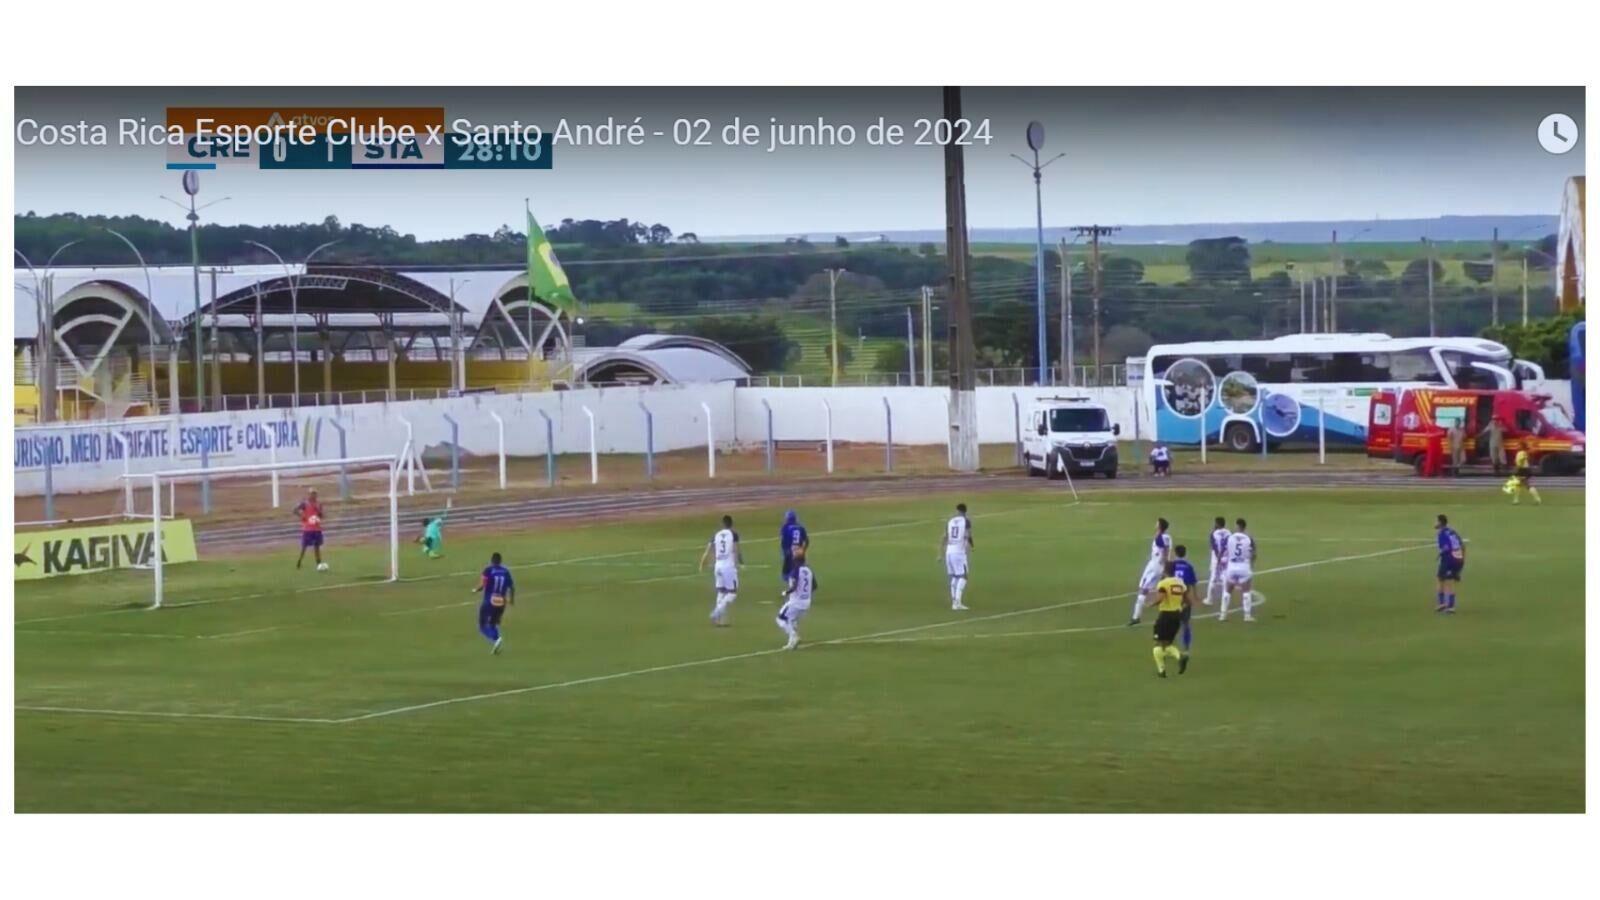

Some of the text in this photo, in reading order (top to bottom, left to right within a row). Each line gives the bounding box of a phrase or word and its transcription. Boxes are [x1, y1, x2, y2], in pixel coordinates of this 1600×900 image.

[1433, 396, 1476, 405] RESGATE
[70, 432, 102, 463] MEIO
[180, 425, 233, 454] ESPORTE
[43, 530, 167, 574] KAGIVA
[719, 540, 726, 554] 3
[1234, 543, 1242, 557] 5
[494, 575, 505, 592] 11
